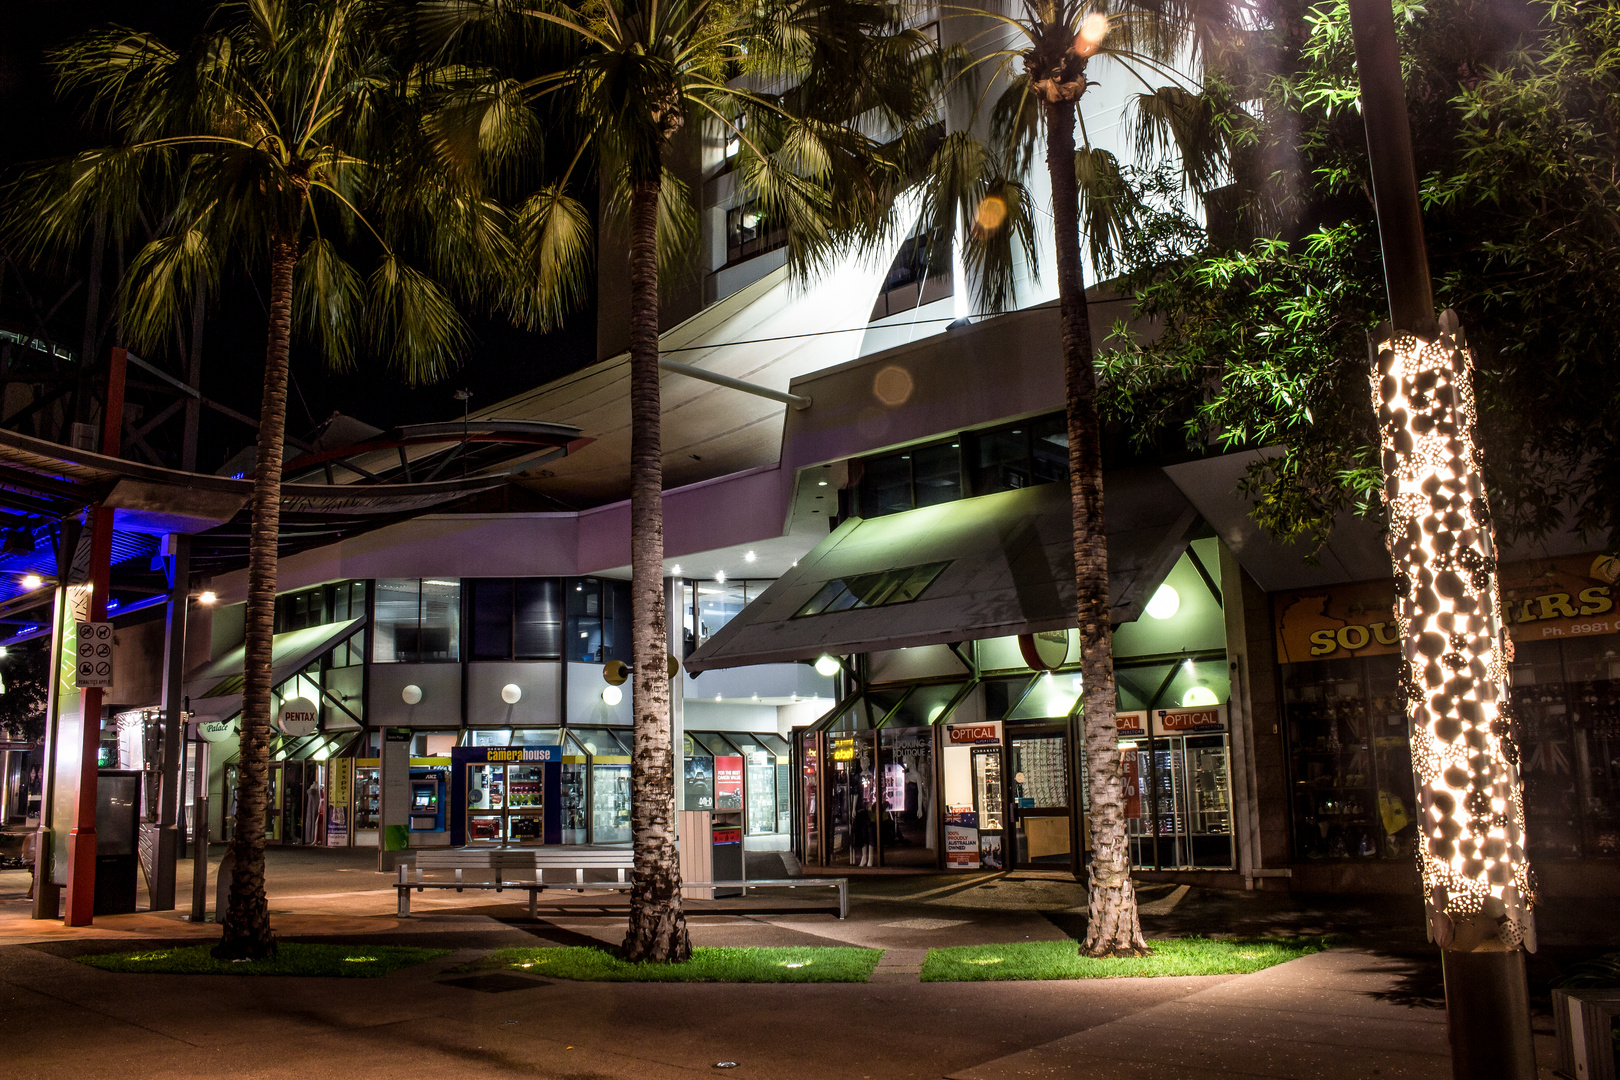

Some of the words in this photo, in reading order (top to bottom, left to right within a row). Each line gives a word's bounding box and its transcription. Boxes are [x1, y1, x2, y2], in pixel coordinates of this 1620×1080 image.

[1543, 627, 1565, 637] Ph.
[1570, 621, 1610, 635] 8981
[285, 711, 315, 722] PENTAX
[1164, 712, 1217, 727] OPTICAL
[206, 722, 229, 733] Palace
[951, 727, 994, 740] OPTICAL
[340, 758, 348, 801] Passport
